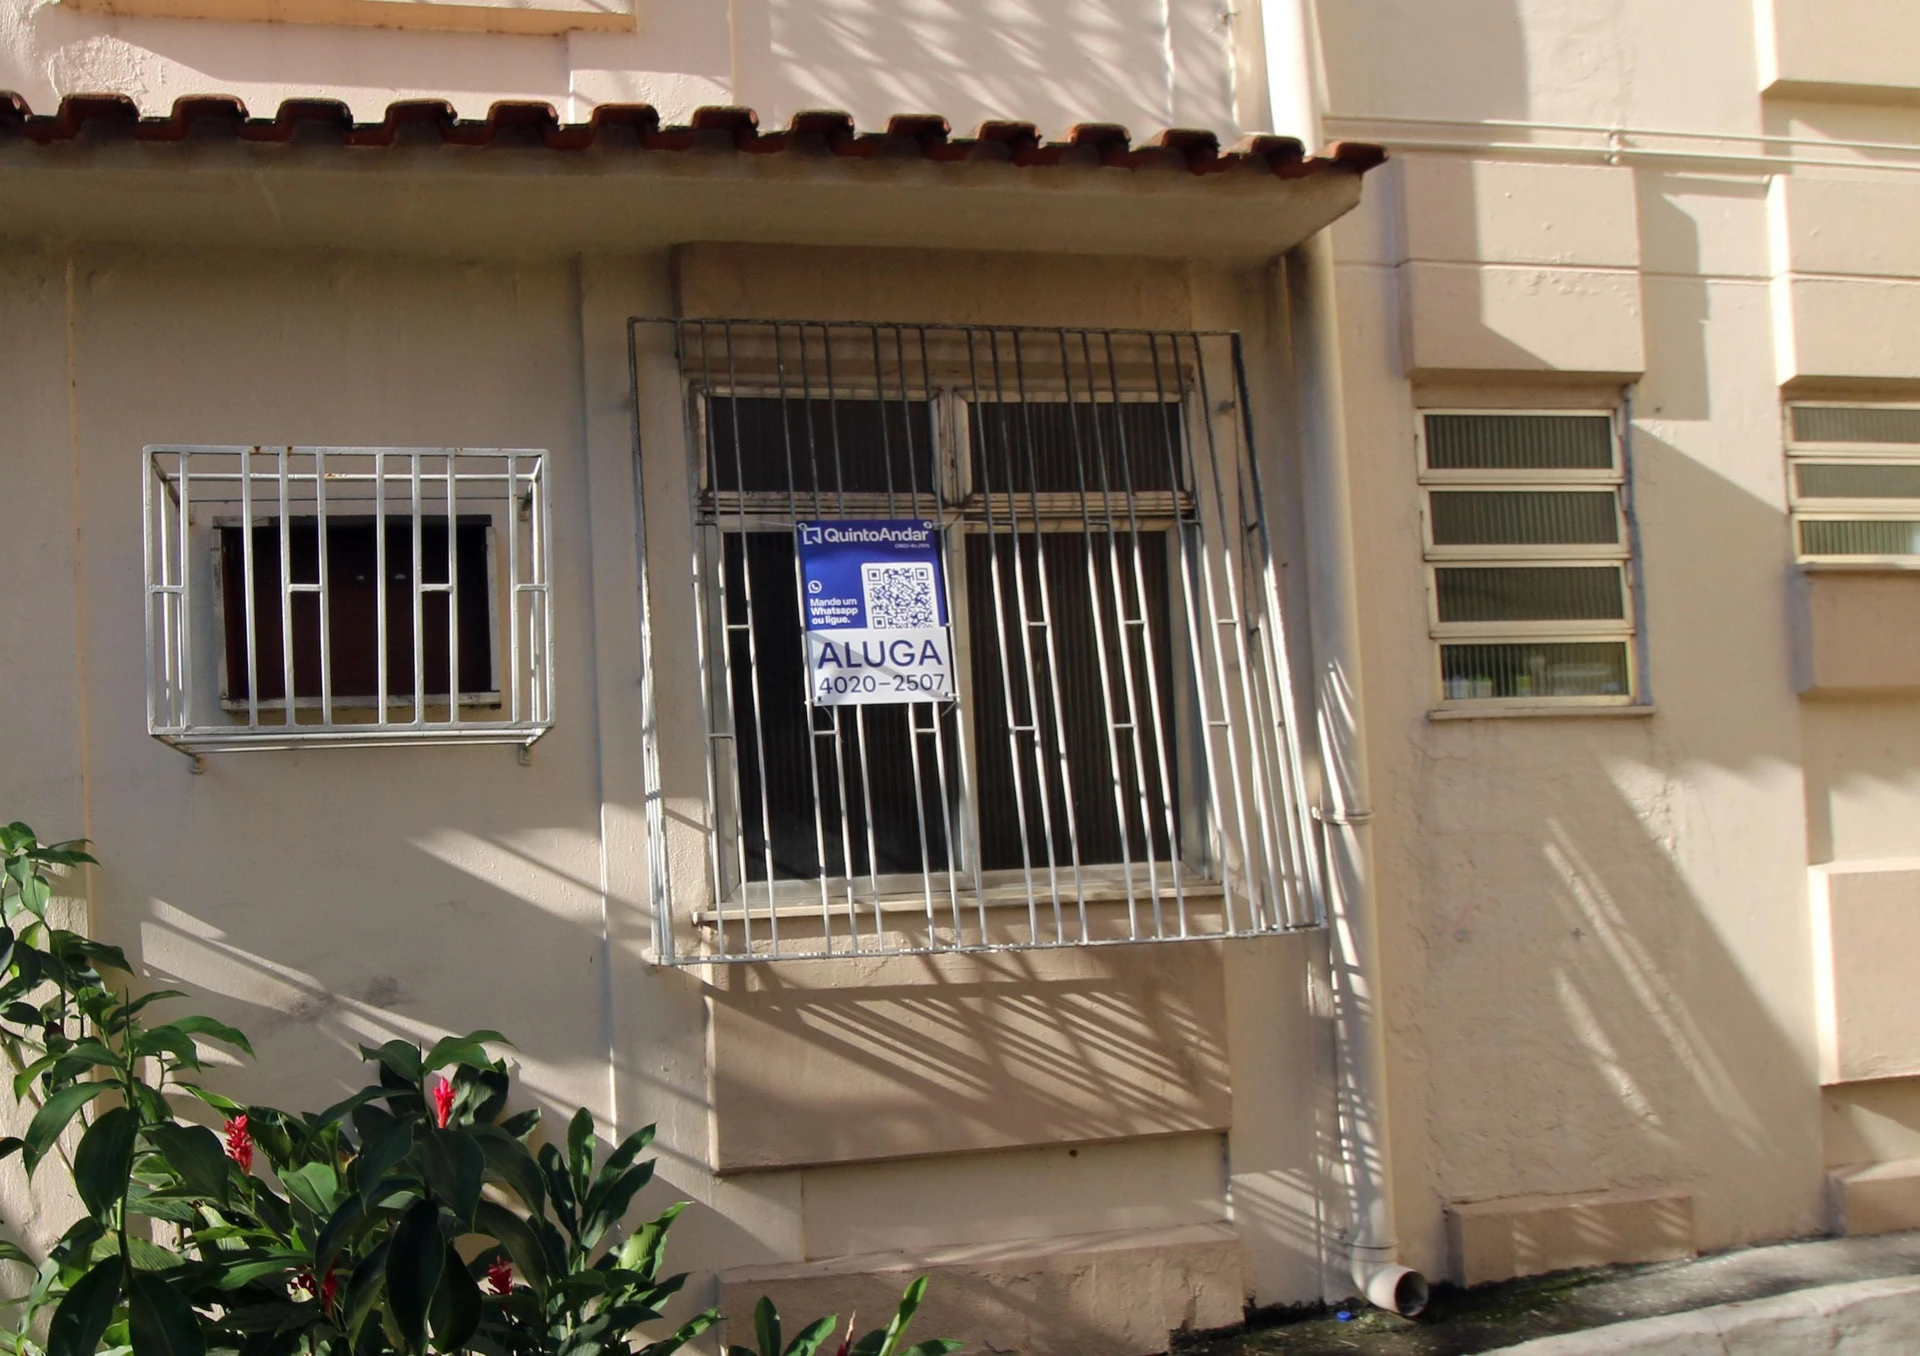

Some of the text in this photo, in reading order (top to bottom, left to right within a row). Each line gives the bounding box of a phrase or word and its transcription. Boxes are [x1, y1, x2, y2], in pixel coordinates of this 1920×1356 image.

[824, 527, 929, 543] QuintoAndar
[810, 598, 841, 606] Mande
[811, 607, 858, 616] Whatsapp
[812, 616, 851, 625] ou ligue.
[817, 639, 943, 669] ALUGA
[819, 673, 945, 694] 4020-2507
